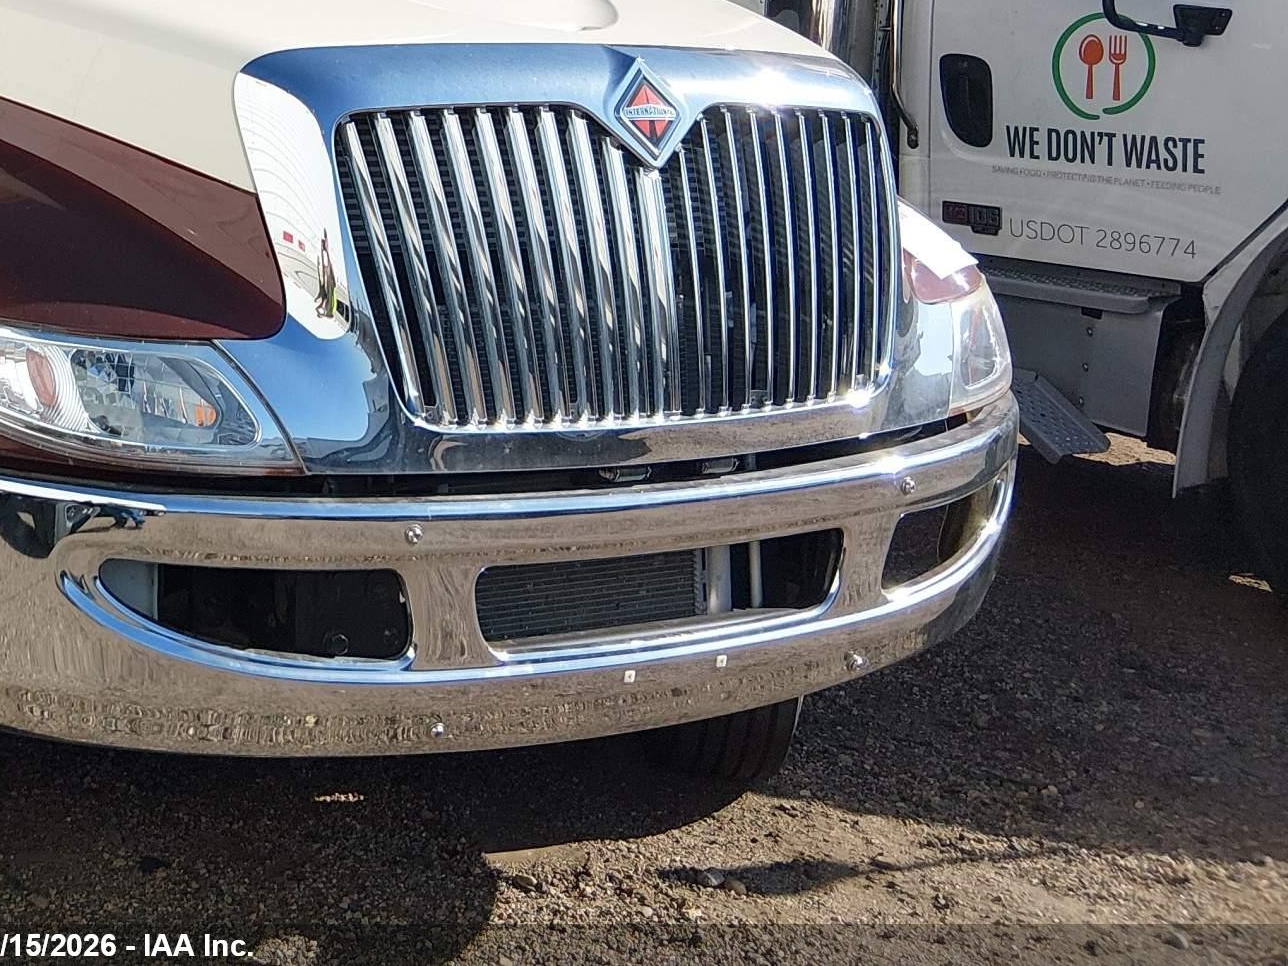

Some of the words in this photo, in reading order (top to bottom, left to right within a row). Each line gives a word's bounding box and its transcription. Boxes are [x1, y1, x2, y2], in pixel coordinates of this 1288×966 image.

[1006, 124, 1039, 160] WE
[1047, 128, 1116, 166] DON'T
[1123, 133, 1206, 174] WASTE
[1009, 218, 1090, 245] USDOT
[1095, 228, 1197, 259] 2896774
